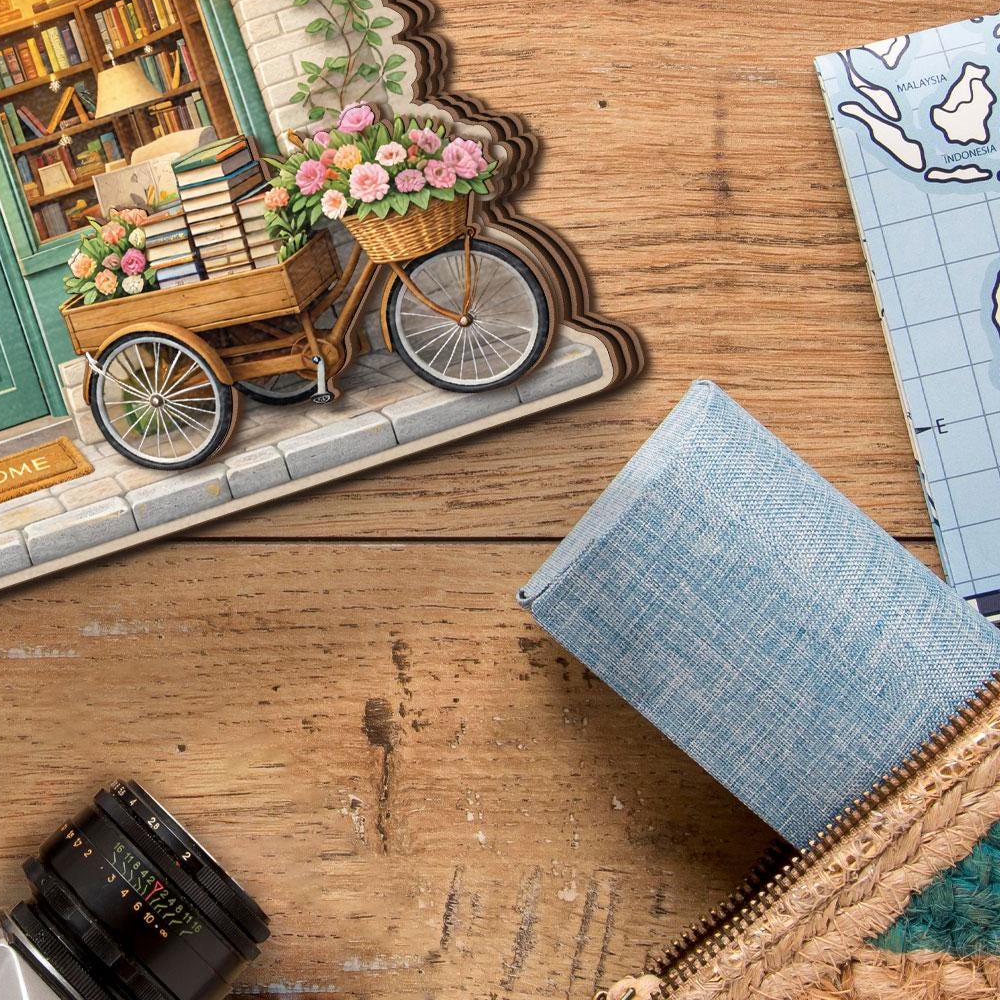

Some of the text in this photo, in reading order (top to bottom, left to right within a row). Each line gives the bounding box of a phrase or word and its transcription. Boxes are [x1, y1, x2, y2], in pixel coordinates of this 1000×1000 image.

[896, 73, 948, 93] MALAYSIA
[943, 144, 997, 164] INDONESIA
[935, 418, 949, 435] E
[182, 851, 192, 861] 2
[83, 849, 155, 924] 2 3 4 6 10
[113, 841, 125, 853] 16
[124, 852, 134, 864] 11
[140, 869, 149, 878] 4
[147, 876, 155, 884] 2
[159, 889, 169, 898] 2
[168, 898, 176, 906] 4
[191, 921, 202, 933] 16
